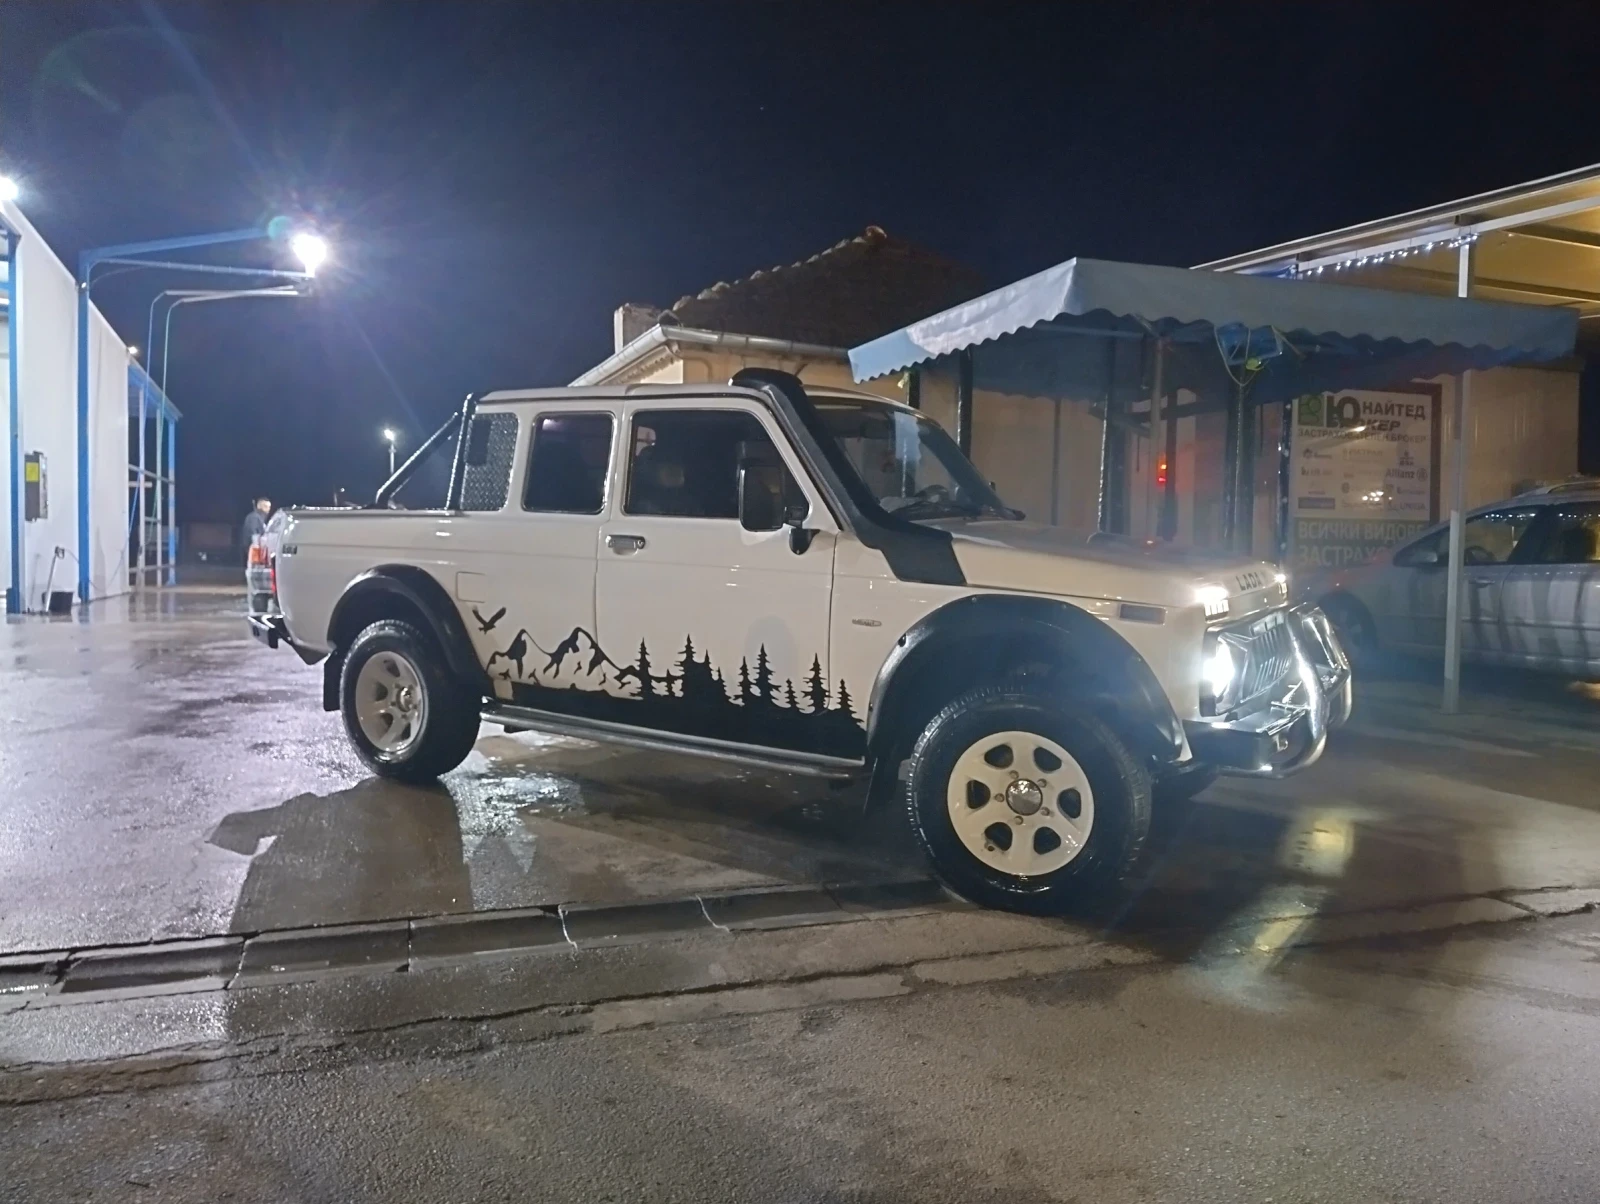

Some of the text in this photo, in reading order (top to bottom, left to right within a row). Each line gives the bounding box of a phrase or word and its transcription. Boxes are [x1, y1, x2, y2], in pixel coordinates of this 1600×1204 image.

[1391, 433, 1427, 444] БРОКЕР
[1385, 468, 1415, 479] Allianz
[1298, 520, 1361, 539] ВСИЧКИ
[1235, 572, 1263, 591] LADA
